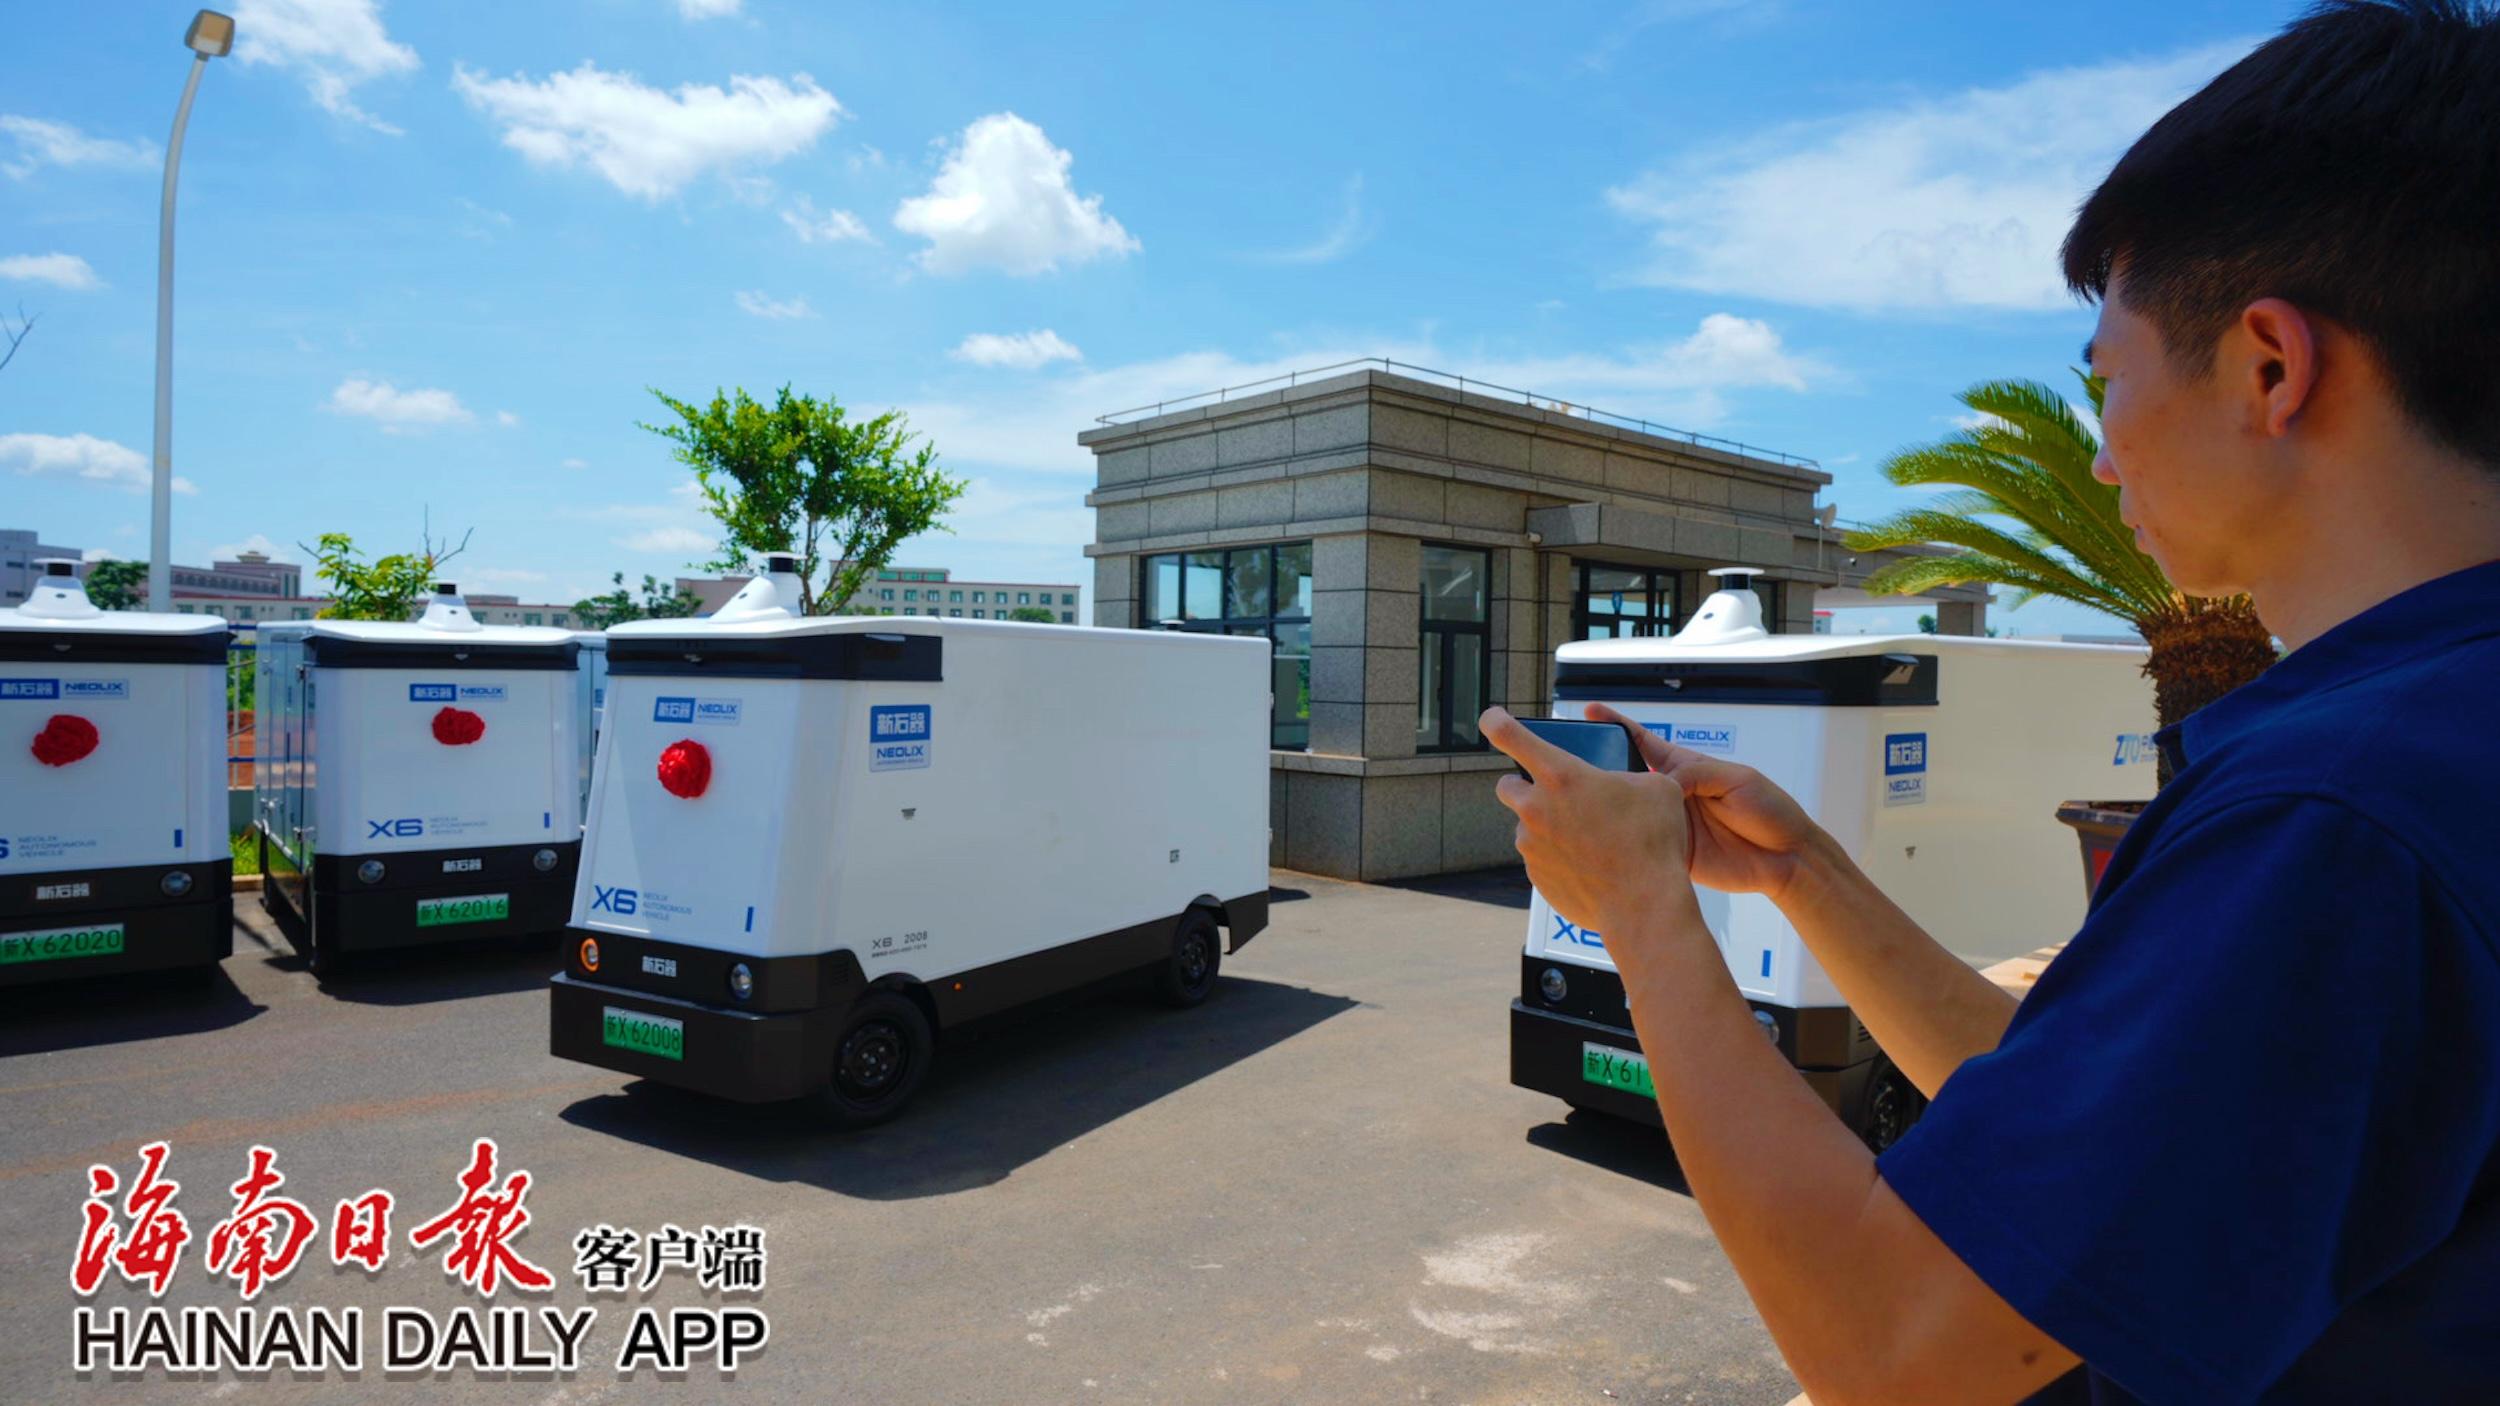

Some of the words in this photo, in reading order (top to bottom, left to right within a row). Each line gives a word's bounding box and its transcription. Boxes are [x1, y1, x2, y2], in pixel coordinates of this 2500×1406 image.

[697, 704, 737, 713] NEOLIX
[877, 712, 925, 735] 新石器
[1676, 730, 1729, 741] NEOLIX
[877, 746, 924, 759] NEOLIX
[1889, 742, 1922, 766] 新石器
[1889, 778, 1922, 793] NEOLIX
[367, 818, 423, 838] X6
[442, 858, 482, 873] 新石器
[36, 882, 90, 900] 新石器
[592, 885, 638, 915] X6
[872, 937, 892, 949] X6
[642, 955, 677, 977] 新石器
